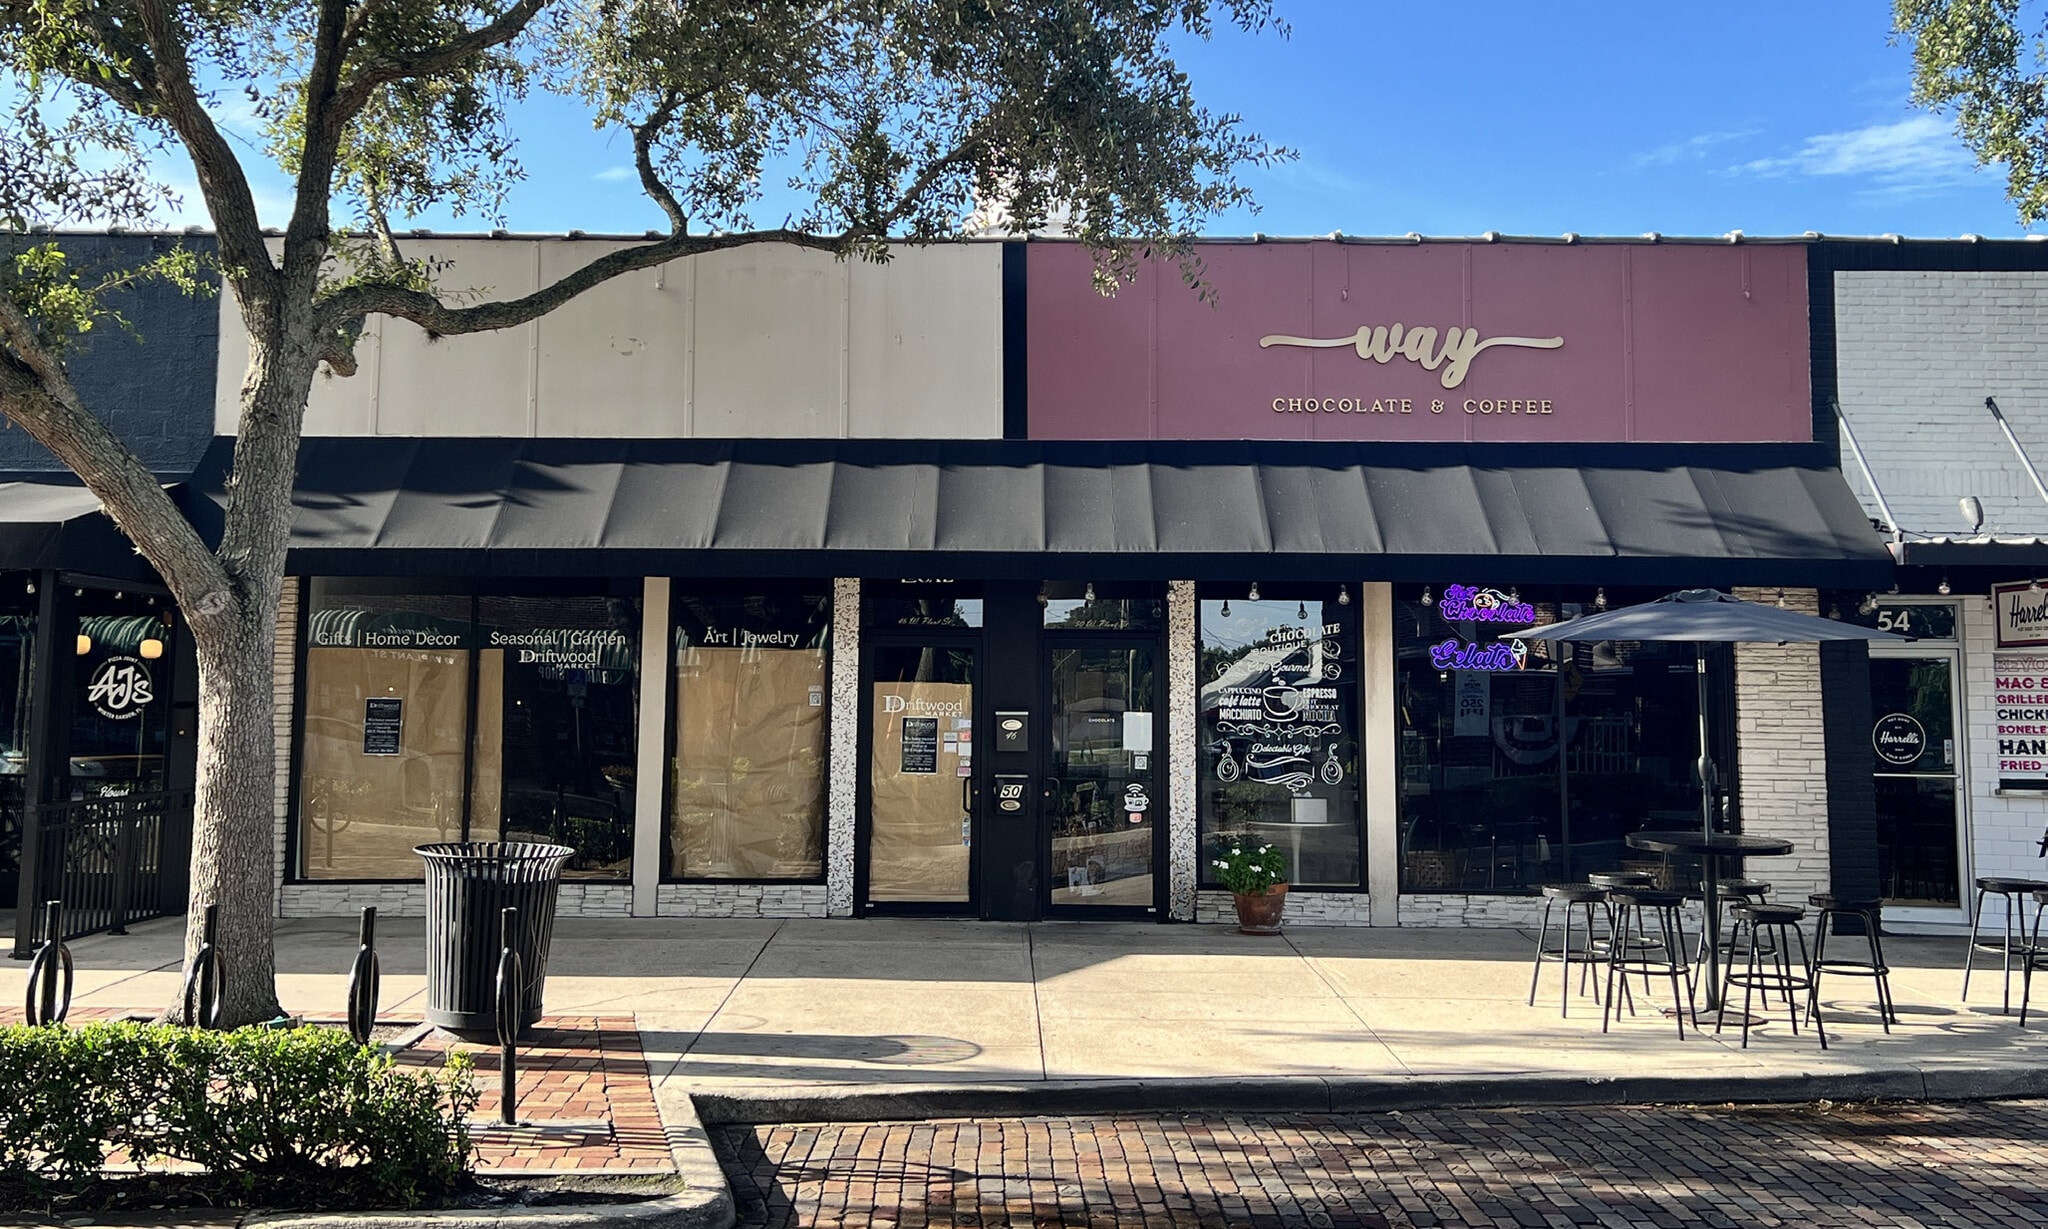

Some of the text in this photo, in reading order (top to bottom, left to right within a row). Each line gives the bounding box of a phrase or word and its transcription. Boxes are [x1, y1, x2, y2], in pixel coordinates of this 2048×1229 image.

[1271, 397, 1554, 415] CHOCOLATE & COFFEE
[1439, 599, 1536, 623] Chocolate
[1877, 610, 1911, 632] 54
[317, 632, 461, 646] Gifts Home Decor
[490, 630, 626, 645] Seasonal Garden
[703, 630, 799, 648] Art Jewelry
[1269, 623, 1341, 644] CHOCOLATE
[1251, 639, 1308, 655] BOUTIQUE
[518, 649, 597, 664] Driftwood
[1430, 639, 1517, 671] Gelato
[88, 665, 154, 709] AJ's
[1995, 677, 2035, 689] MAC
[1239, 694, 1262, 706] latte
[1302, 687, 1338, 699] ESPRESSO
[882, 695, 963, 713] Driftwood
[1219, 708, 1262, 720] MACCHIATO
[1006, 731, 1017, 740] 46
[1999, 739, 2047, 755] HAN
[2000, 760, 2042, 771] FRIED
[1001, 785, 1021, 799] 50
